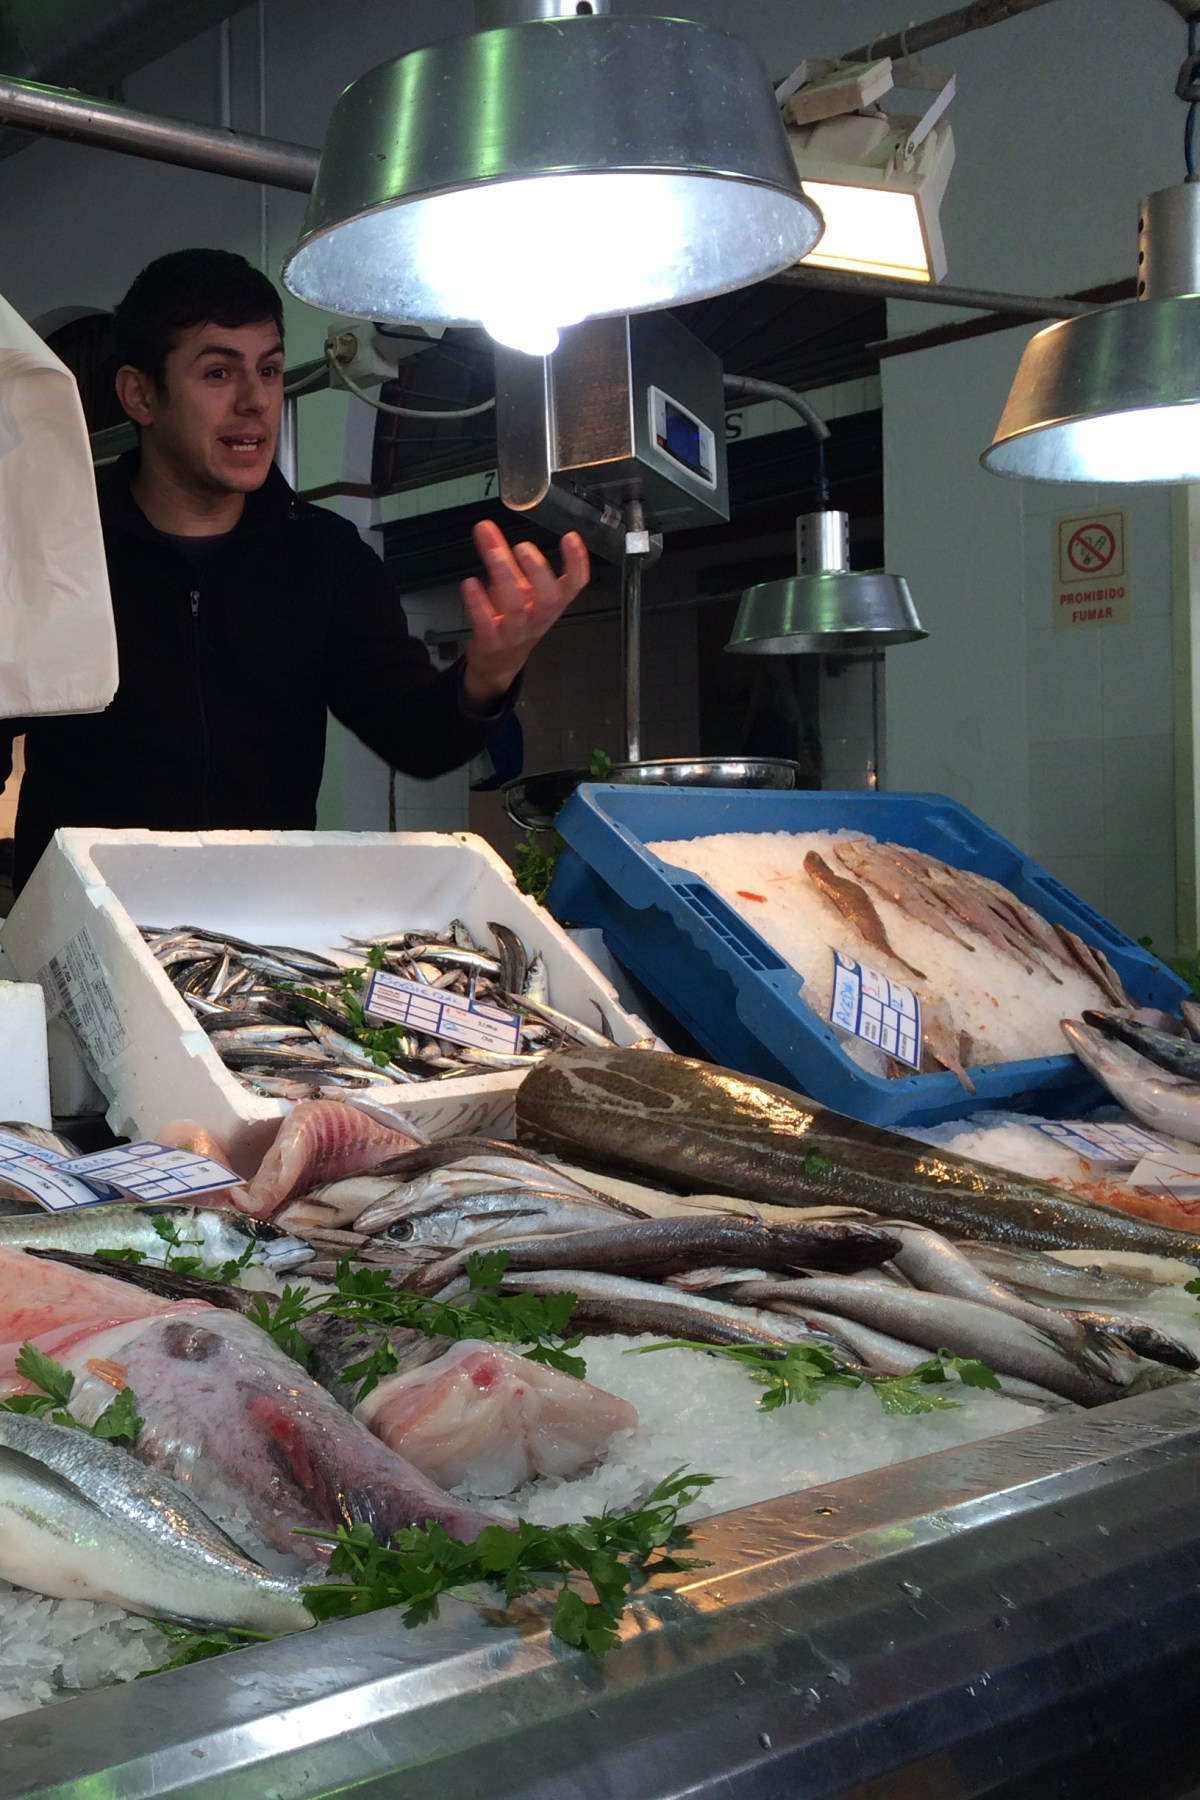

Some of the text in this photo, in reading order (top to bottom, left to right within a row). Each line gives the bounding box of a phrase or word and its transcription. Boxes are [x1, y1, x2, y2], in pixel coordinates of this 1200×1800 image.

[485, 472, 496, 497] 7
[1060, 587, 1125, 605] PROHIBIDO
[1072, 607, 1113, 622] FUMAR
